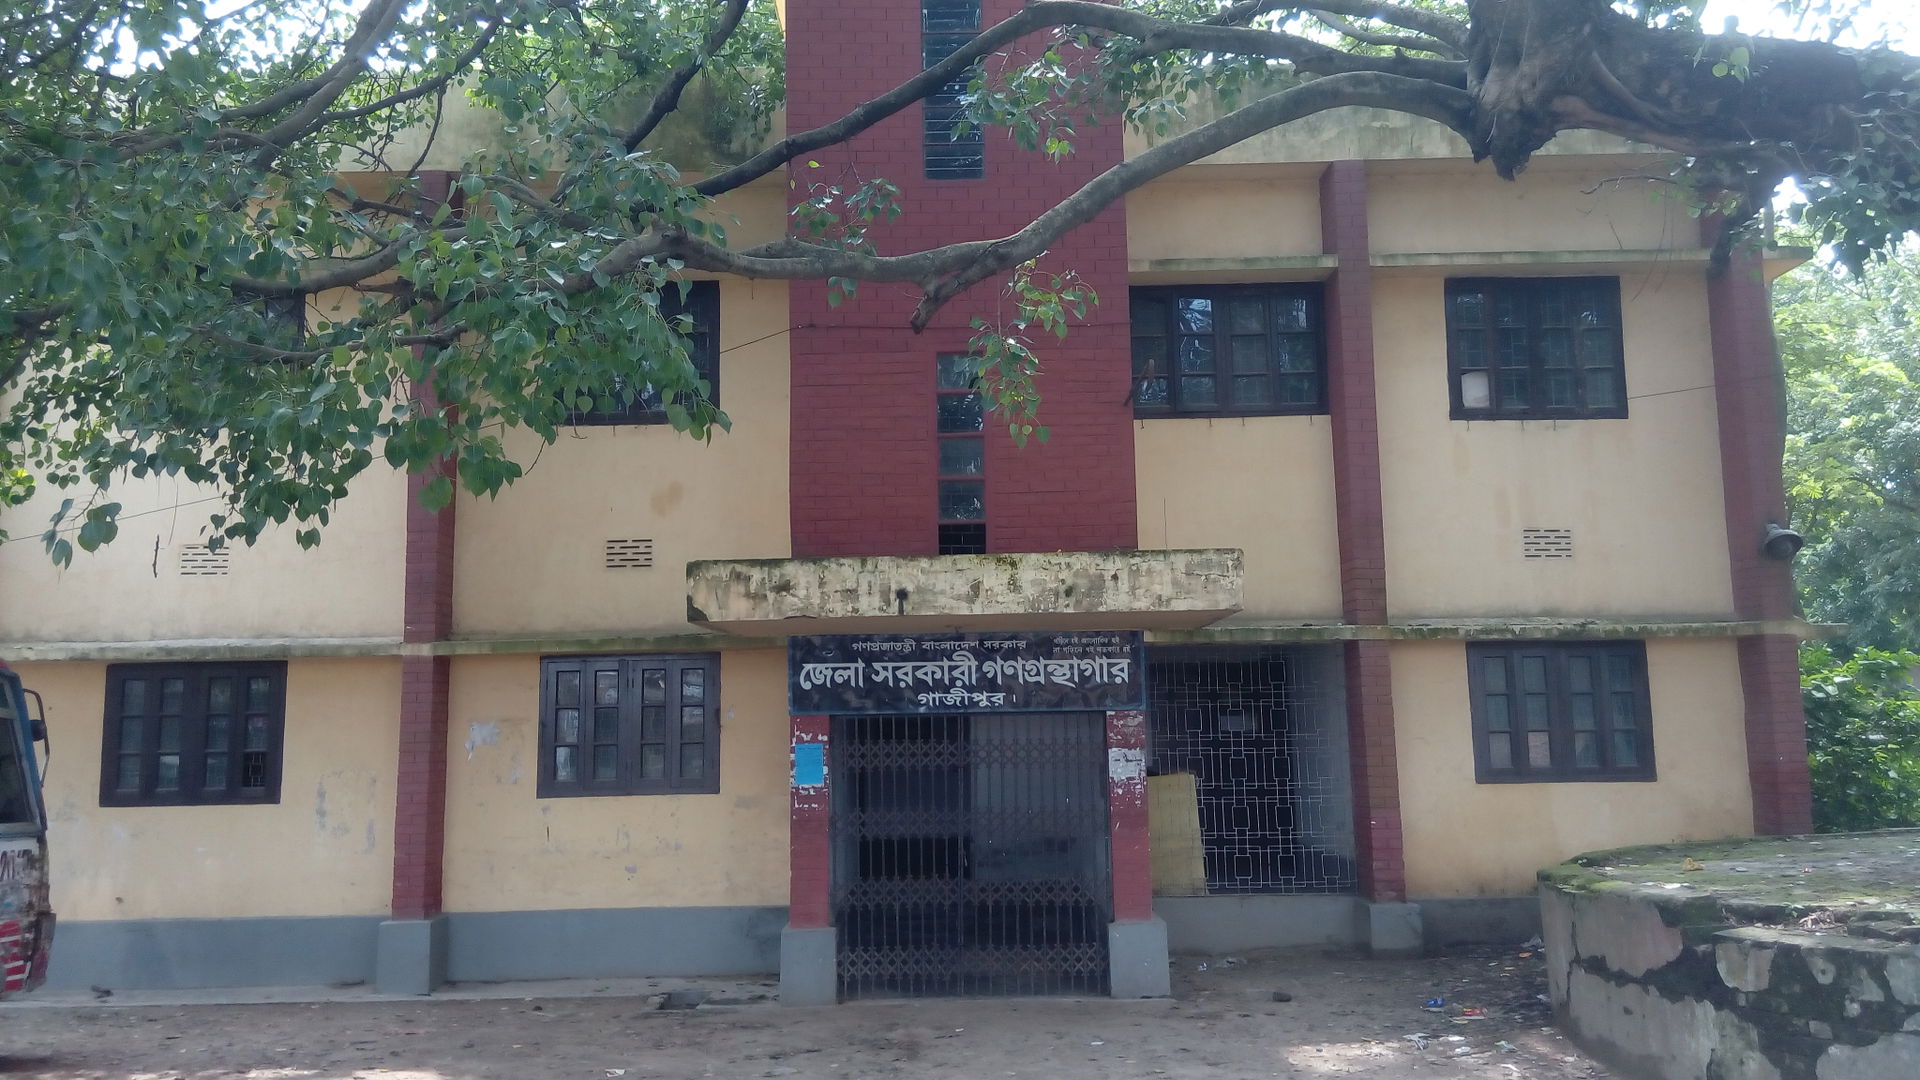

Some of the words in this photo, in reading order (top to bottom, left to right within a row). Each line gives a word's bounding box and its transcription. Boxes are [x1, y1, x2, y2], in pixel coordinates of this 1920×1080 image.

[921, 640, 979, 651] বাংলাদেশ
[983, 639, 1027, 650] সরকার
[800, 657, 866, 691] জেলা
[871, 650, 979, 688] সরকারী
[982, 655, 1131, 688] গণগ্রন্থাগার
[917, 687, 1006, 707] গাজীপুর
